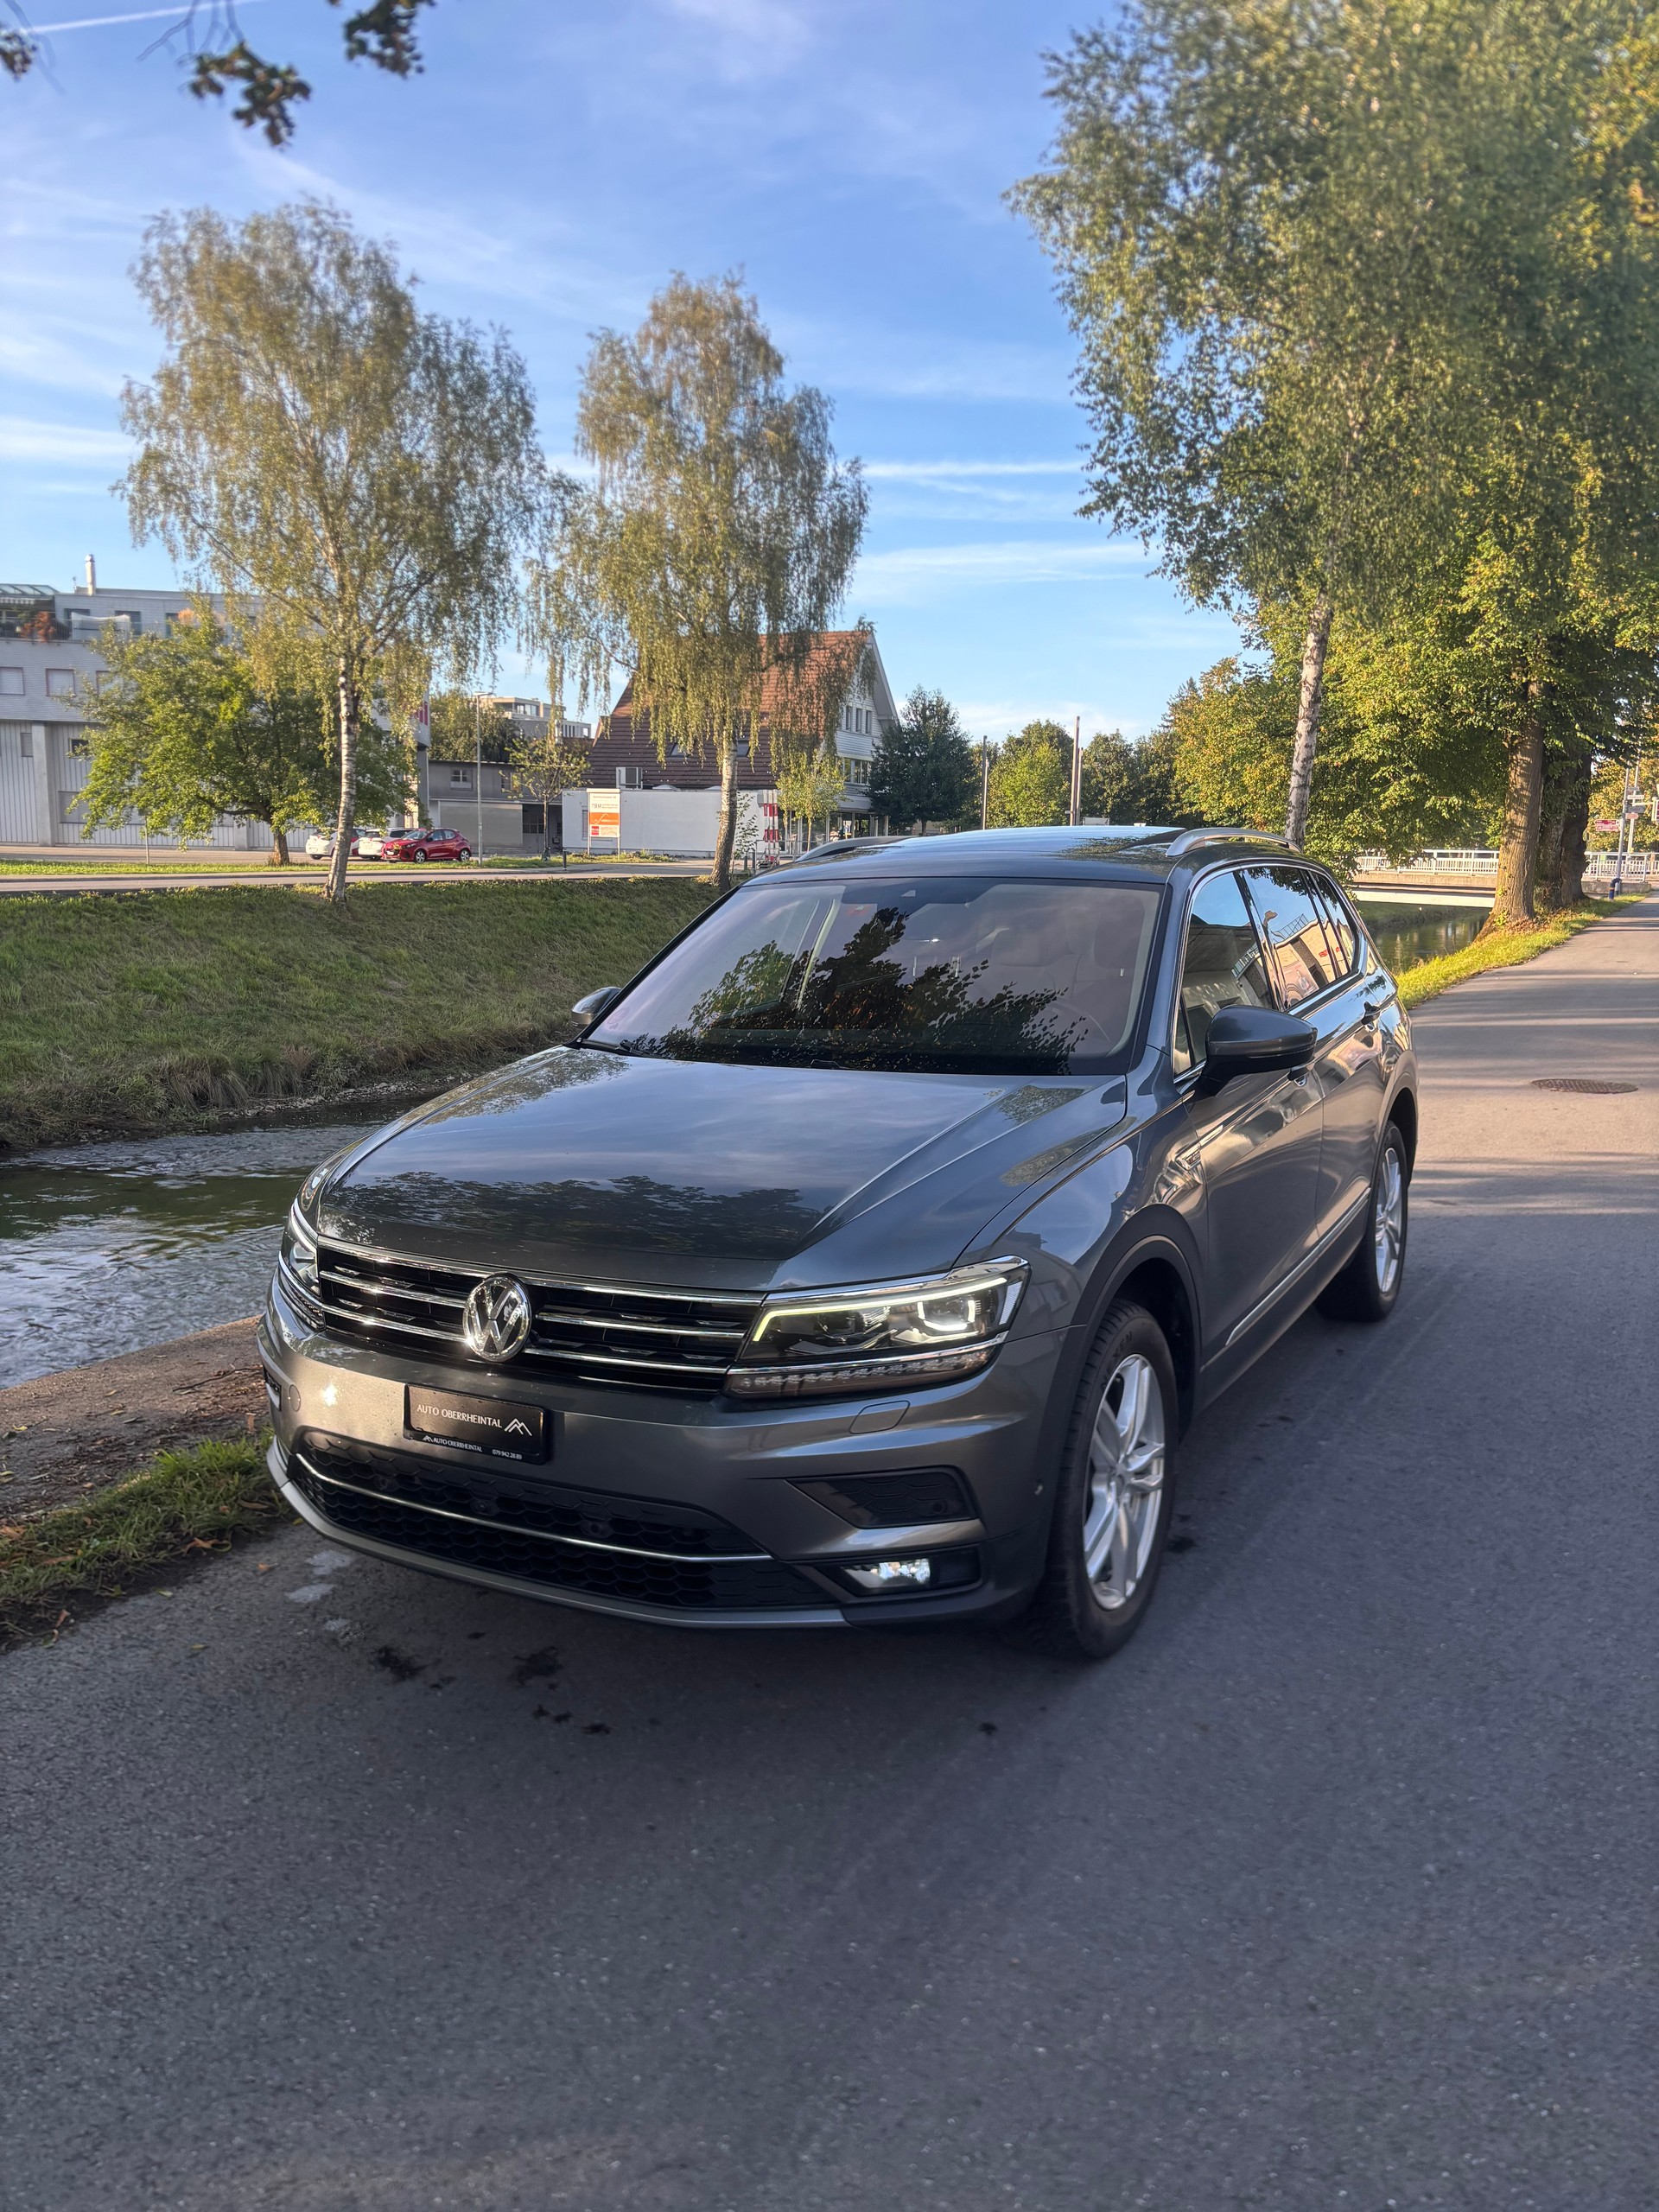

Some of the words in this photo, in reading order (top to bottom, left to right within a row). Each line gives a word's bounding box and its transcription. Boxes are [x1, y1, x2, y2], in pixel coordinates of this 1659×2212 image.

[416, 1404, 440, 1416] AUTO
[442, 1408, 503, 1428] OBERRHEINTAL
[433, 1437, 448, 1446] AUTO
